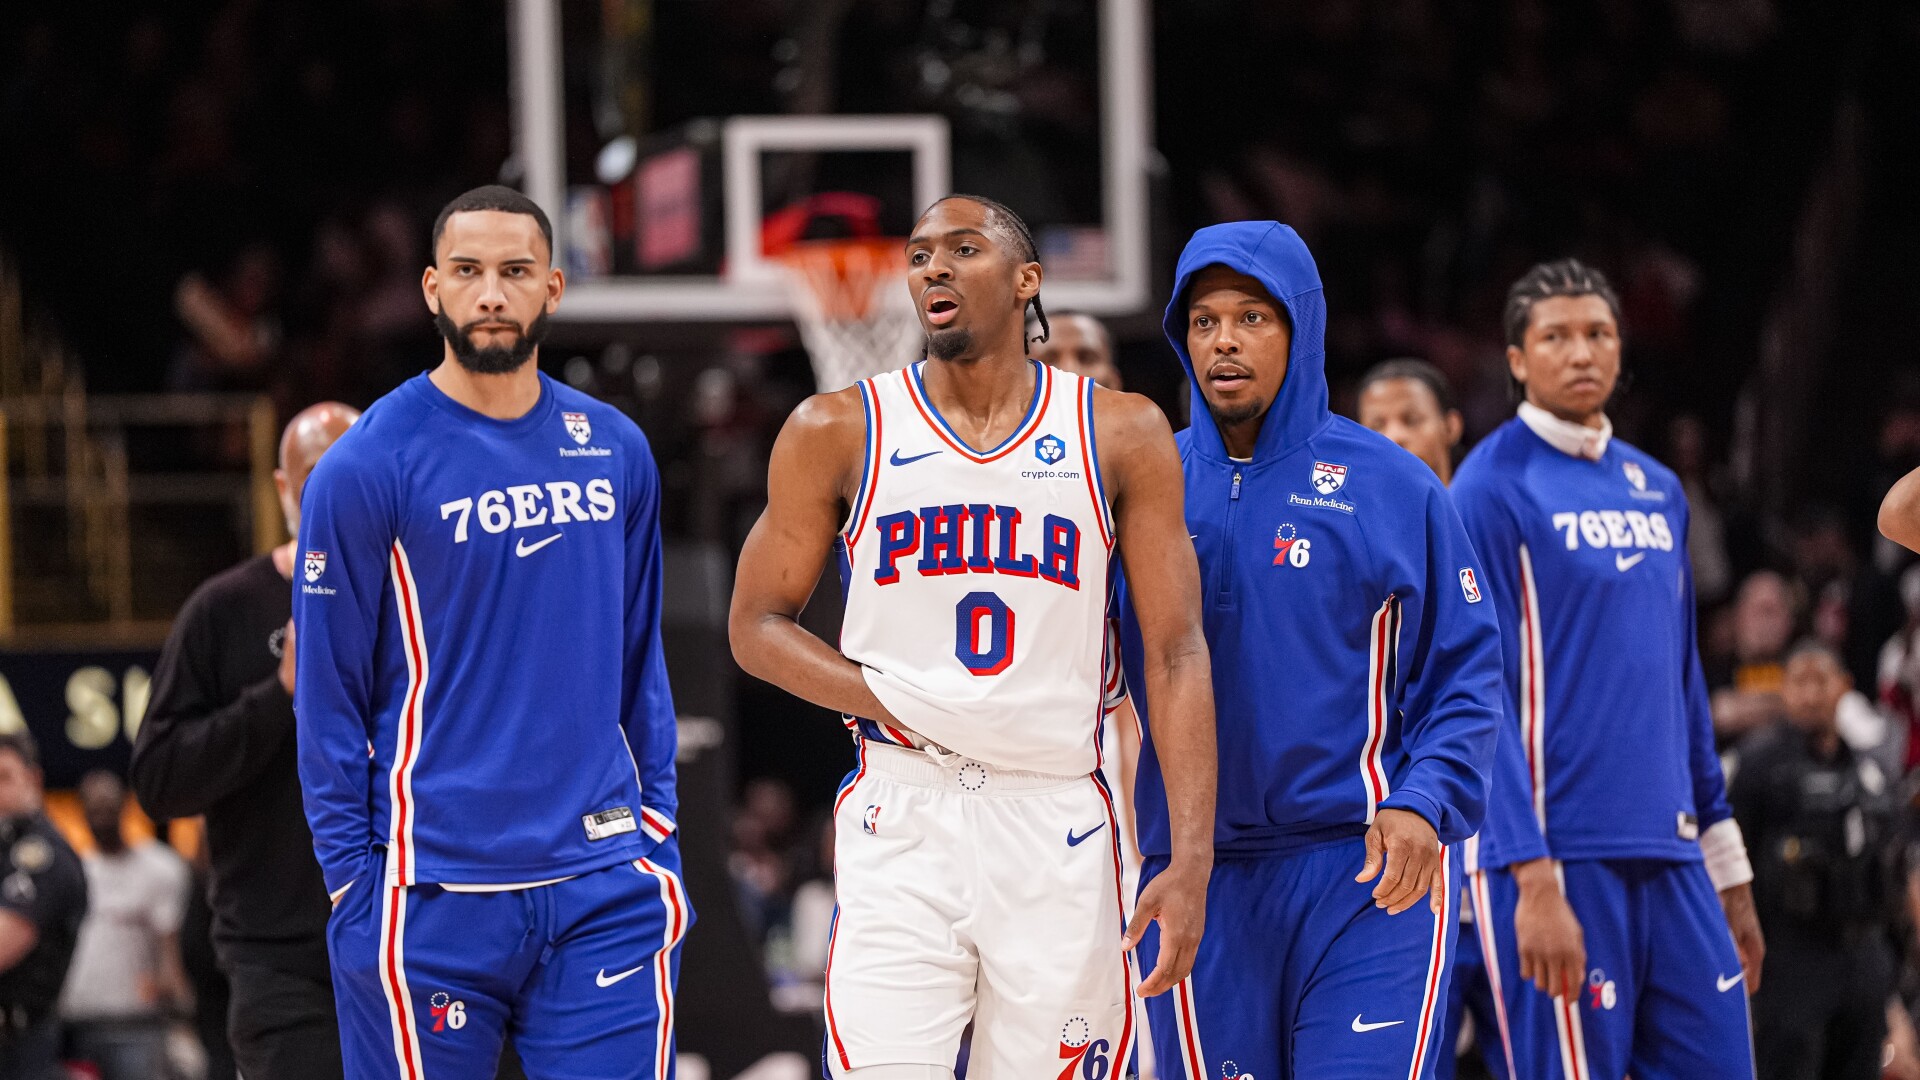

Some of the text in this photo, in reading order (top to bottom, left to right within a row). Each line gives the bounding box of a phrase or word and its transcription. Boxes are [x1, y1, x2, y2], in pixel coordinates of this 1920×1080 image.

[1021, 470, 1080, 479] crypto.com
[440, 478, 616, 543] 76ERS
[1290, 494, 1354, 513] Penn Medicine
[874, 503, 1081, 591] PHILA
[1552, 509, 1673, 552] 76ERS
[1272, 536, 1311, 568] 76
[955, 591, 1015, 677] 0
[431, 1000, 467, 1032] 76
[1057, 1038, 1110, 1080] 76
